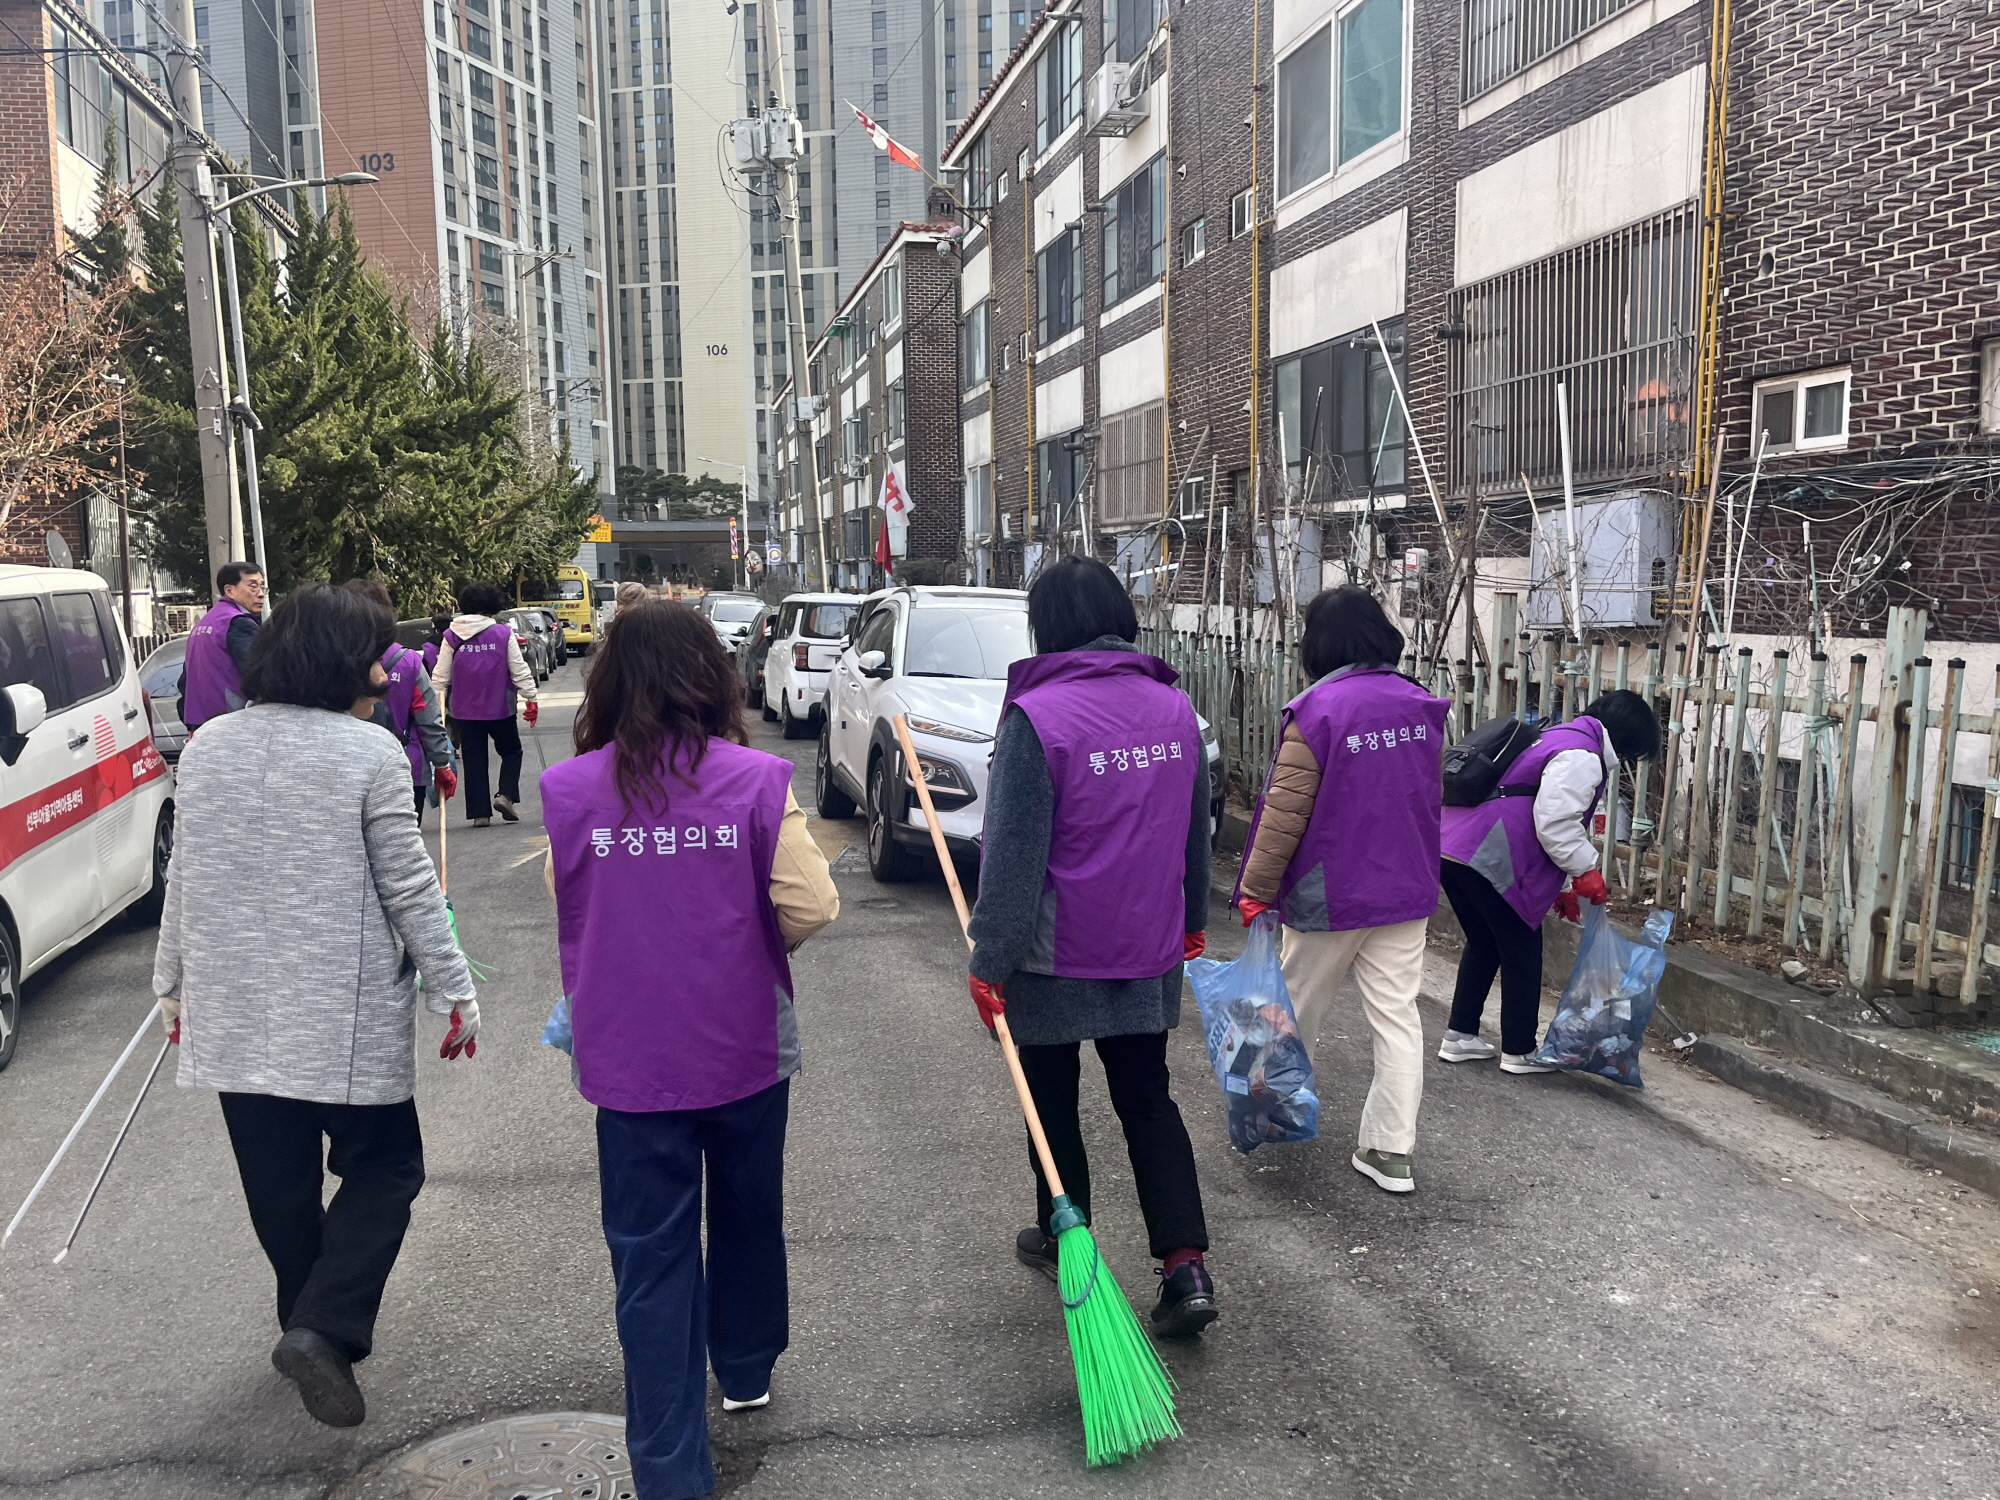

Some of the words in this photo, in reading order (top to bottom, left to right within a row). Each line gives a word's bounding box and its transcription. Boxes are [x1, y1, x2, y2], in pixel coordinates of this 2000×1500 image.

[360, 153, 394, 172] 103
[706, 344, 728, 356] 106
[1346, 724, 1426, 754] 통장협의회
[1088, 741, 1182, 776] 통장협의회
[590, 825, 737, 856] 통장협의회
